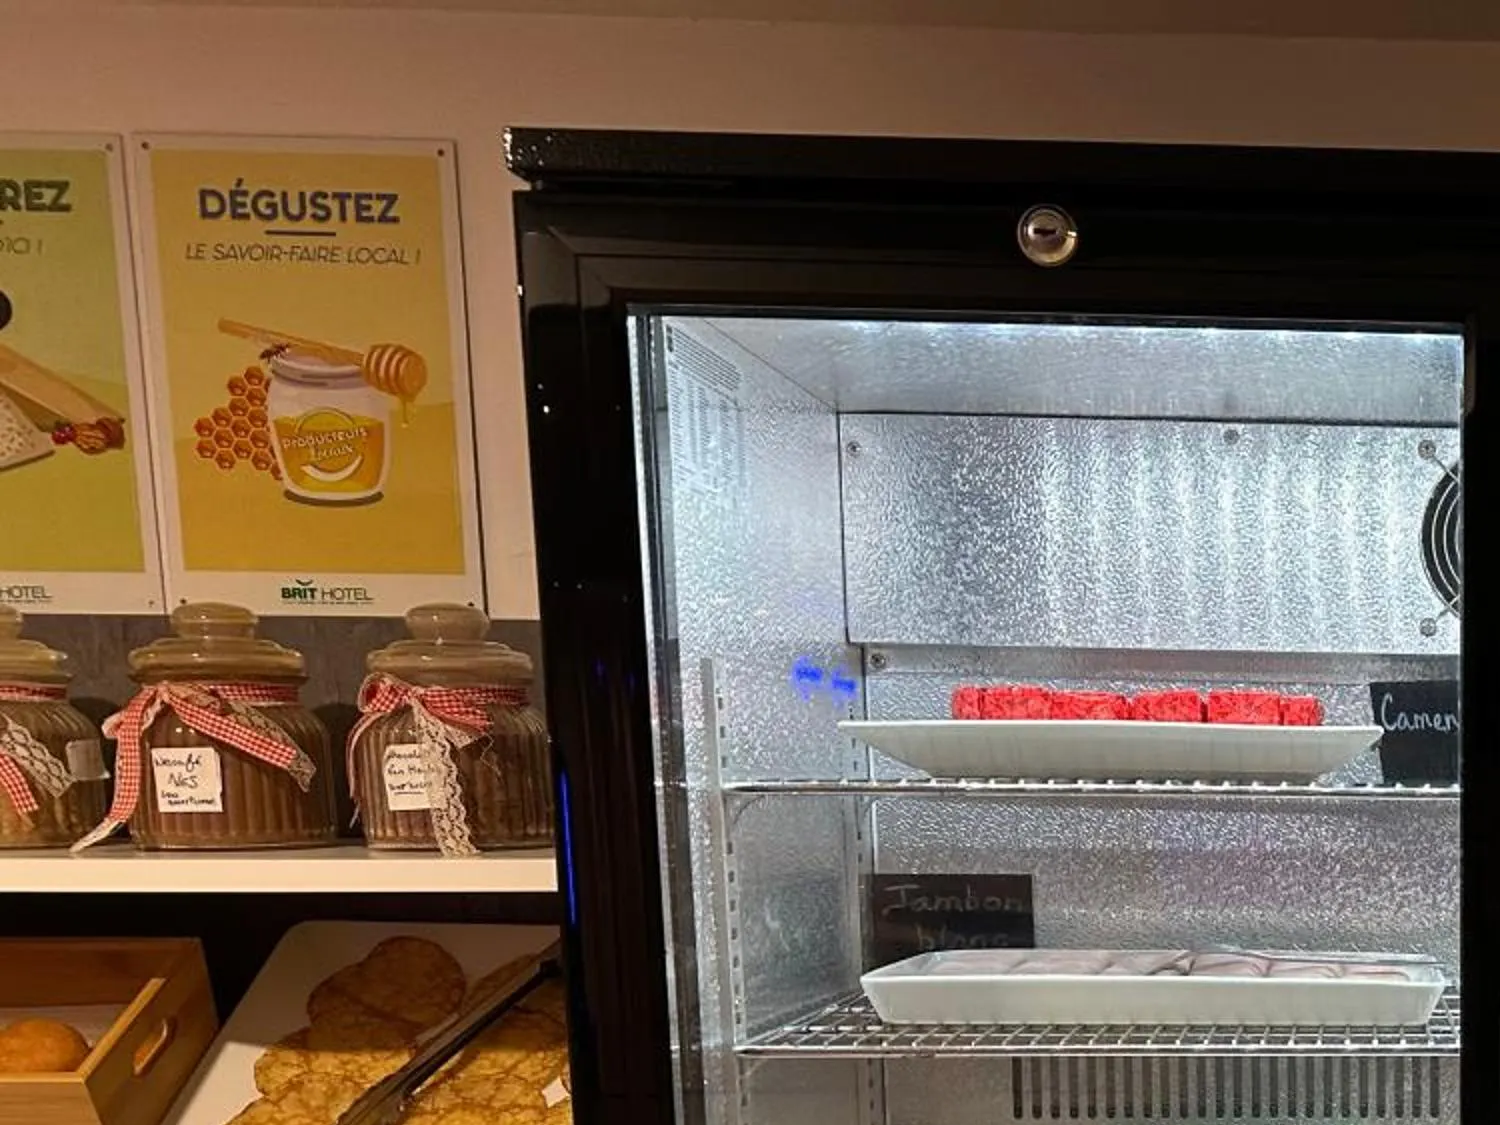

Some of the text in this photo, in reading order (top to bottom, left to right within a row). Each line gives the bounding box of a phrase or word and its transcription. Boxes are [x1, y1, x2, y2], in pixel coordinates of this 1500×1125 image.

[199, 178, 400, 223] DÉGUSTEZ
[186, 243, 206, 261] LE
[212, 243, 341, 264] SAVOIR-FAIRE
[347, 247, 410, 265] LOCAL
[281, 586, 374, 600] BRIT HOTEL
[881, 883, 1024, 917] Jambon
